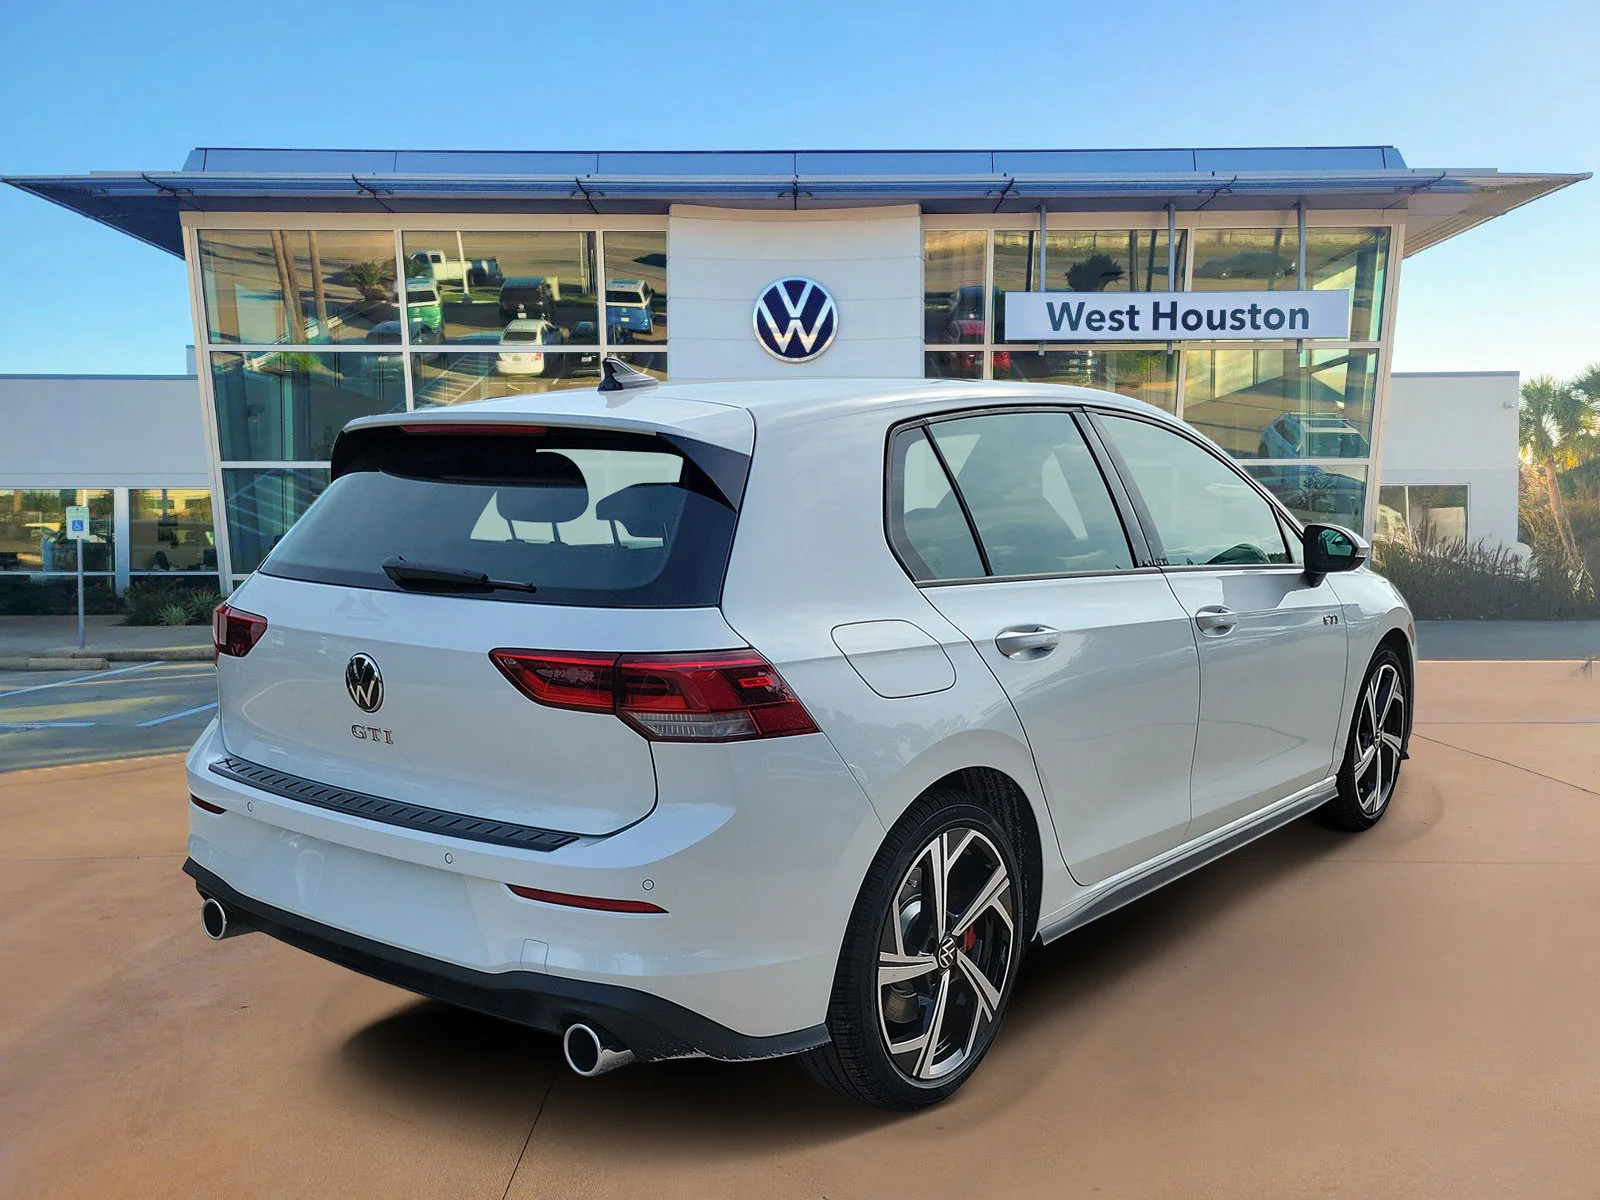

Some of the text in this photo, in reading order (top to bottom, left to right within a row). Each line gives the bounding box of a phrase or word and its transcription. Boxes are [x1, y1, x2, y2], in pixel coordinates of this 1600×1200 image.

[754, 276, 837, 362] VW
[1046, 300, 1309, 331] West Houston
[346, 652, 384, 712] VW
[351, 723, 394, 745] GTI
